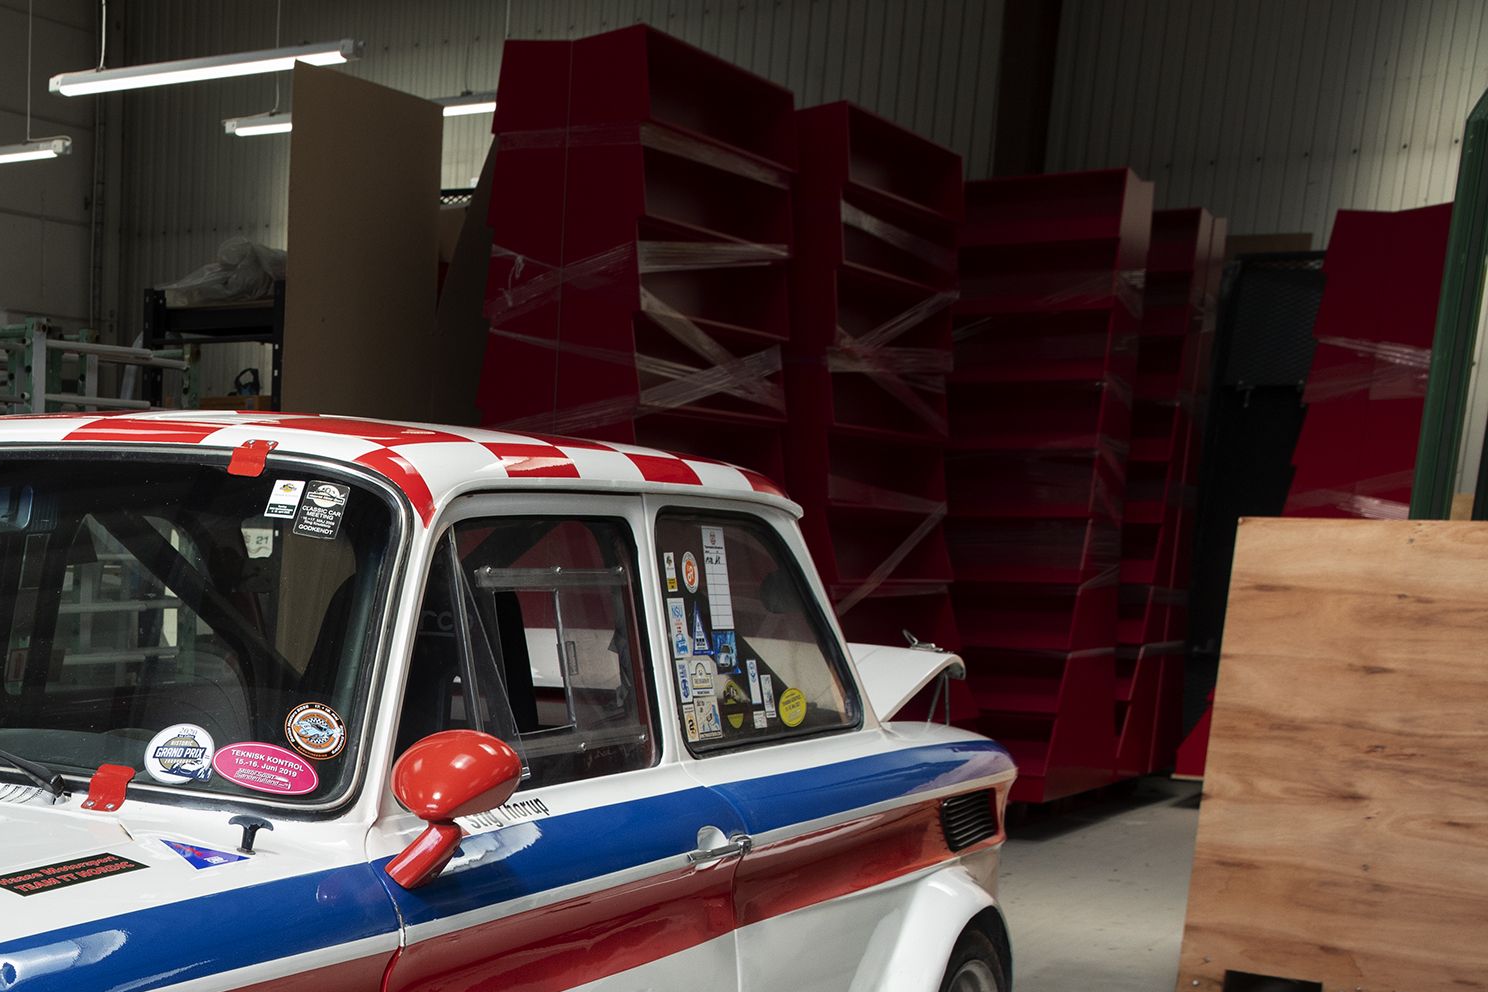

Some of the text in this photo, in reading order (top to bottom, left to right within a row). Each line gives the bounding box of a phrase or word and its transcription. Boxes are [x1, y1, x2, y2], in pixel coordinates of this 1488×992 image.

[302, 505, 327, 515] CLASSIC
[328, 509, 341, 518] CAR
[306, 511, 334, 520] MEETING
[298, 523, 333, 535] GODKENDT
[155, 746, 184, 758] GRAND
[184, 747, 206, 759] PRIX
[231, 749, 304, 773] TEKNISK KONTROL
[261, 763, 278, 772] Juni
[279, 767, 298, 778] 2019
[40, 855, 119, 875] Motorsport
[14, 861, 135, 892] TEAM TT NORDIC
